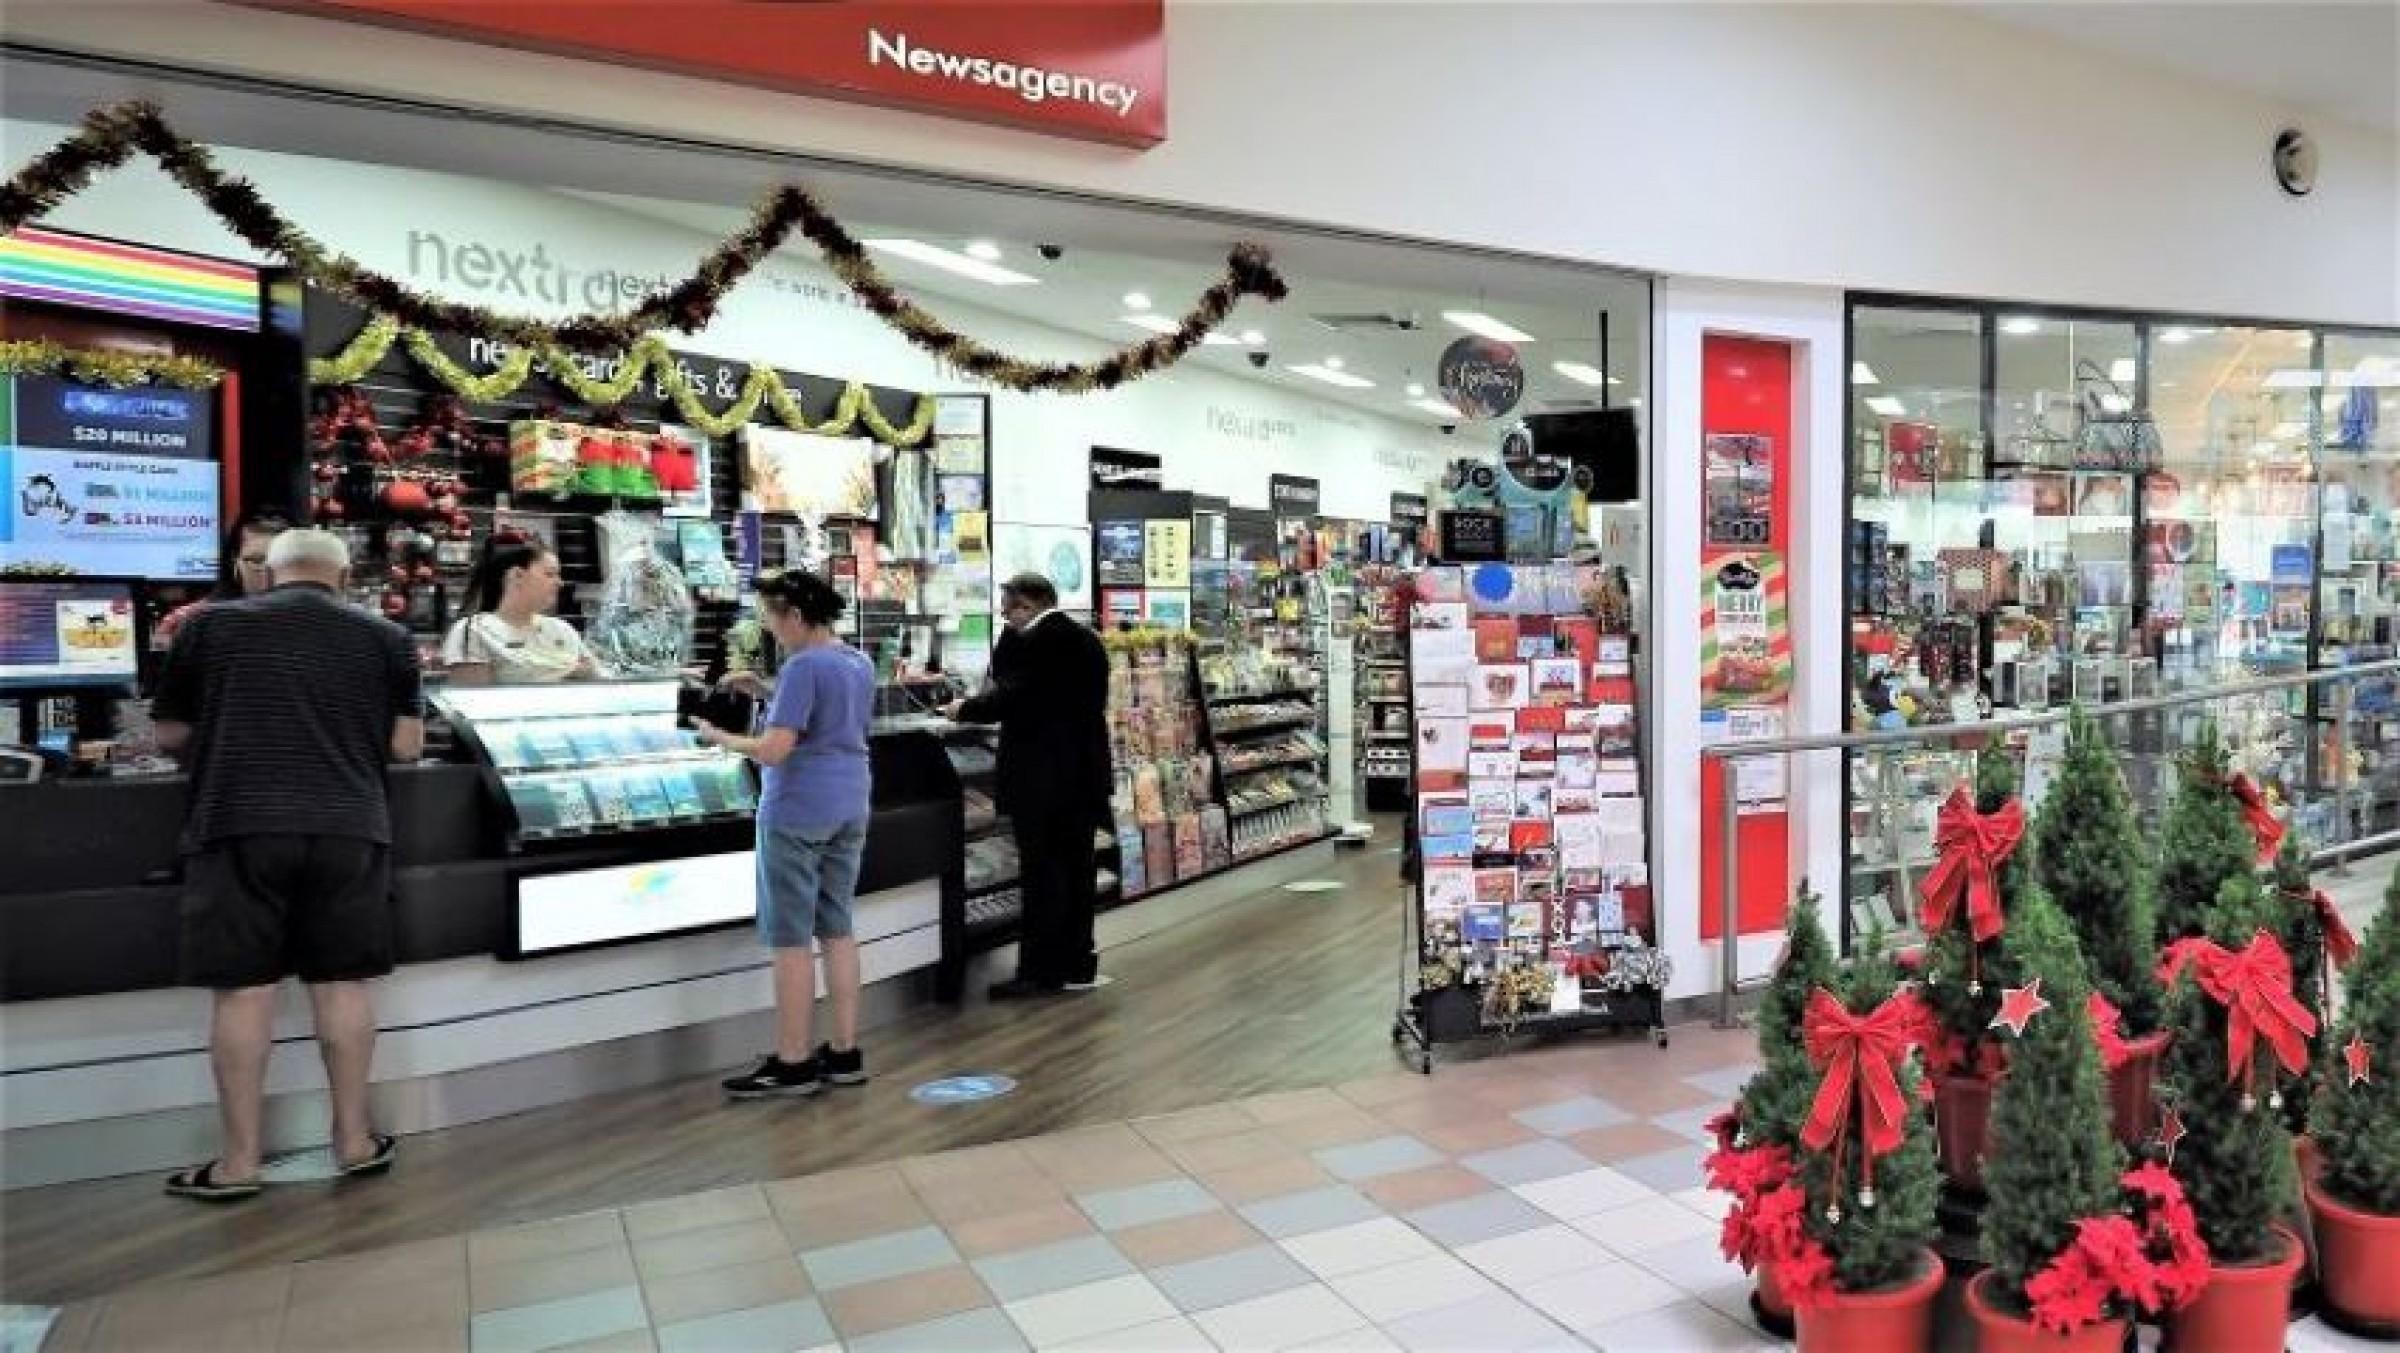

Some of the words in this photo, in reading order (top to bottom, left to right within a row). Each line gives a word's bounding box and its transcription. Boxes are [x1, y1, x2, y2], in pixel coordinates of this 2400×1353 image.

[868, 27, 1138, 117] Newsagency
[715, 366, 738, 400] &
[112, 430, 187, 448] MILLION
